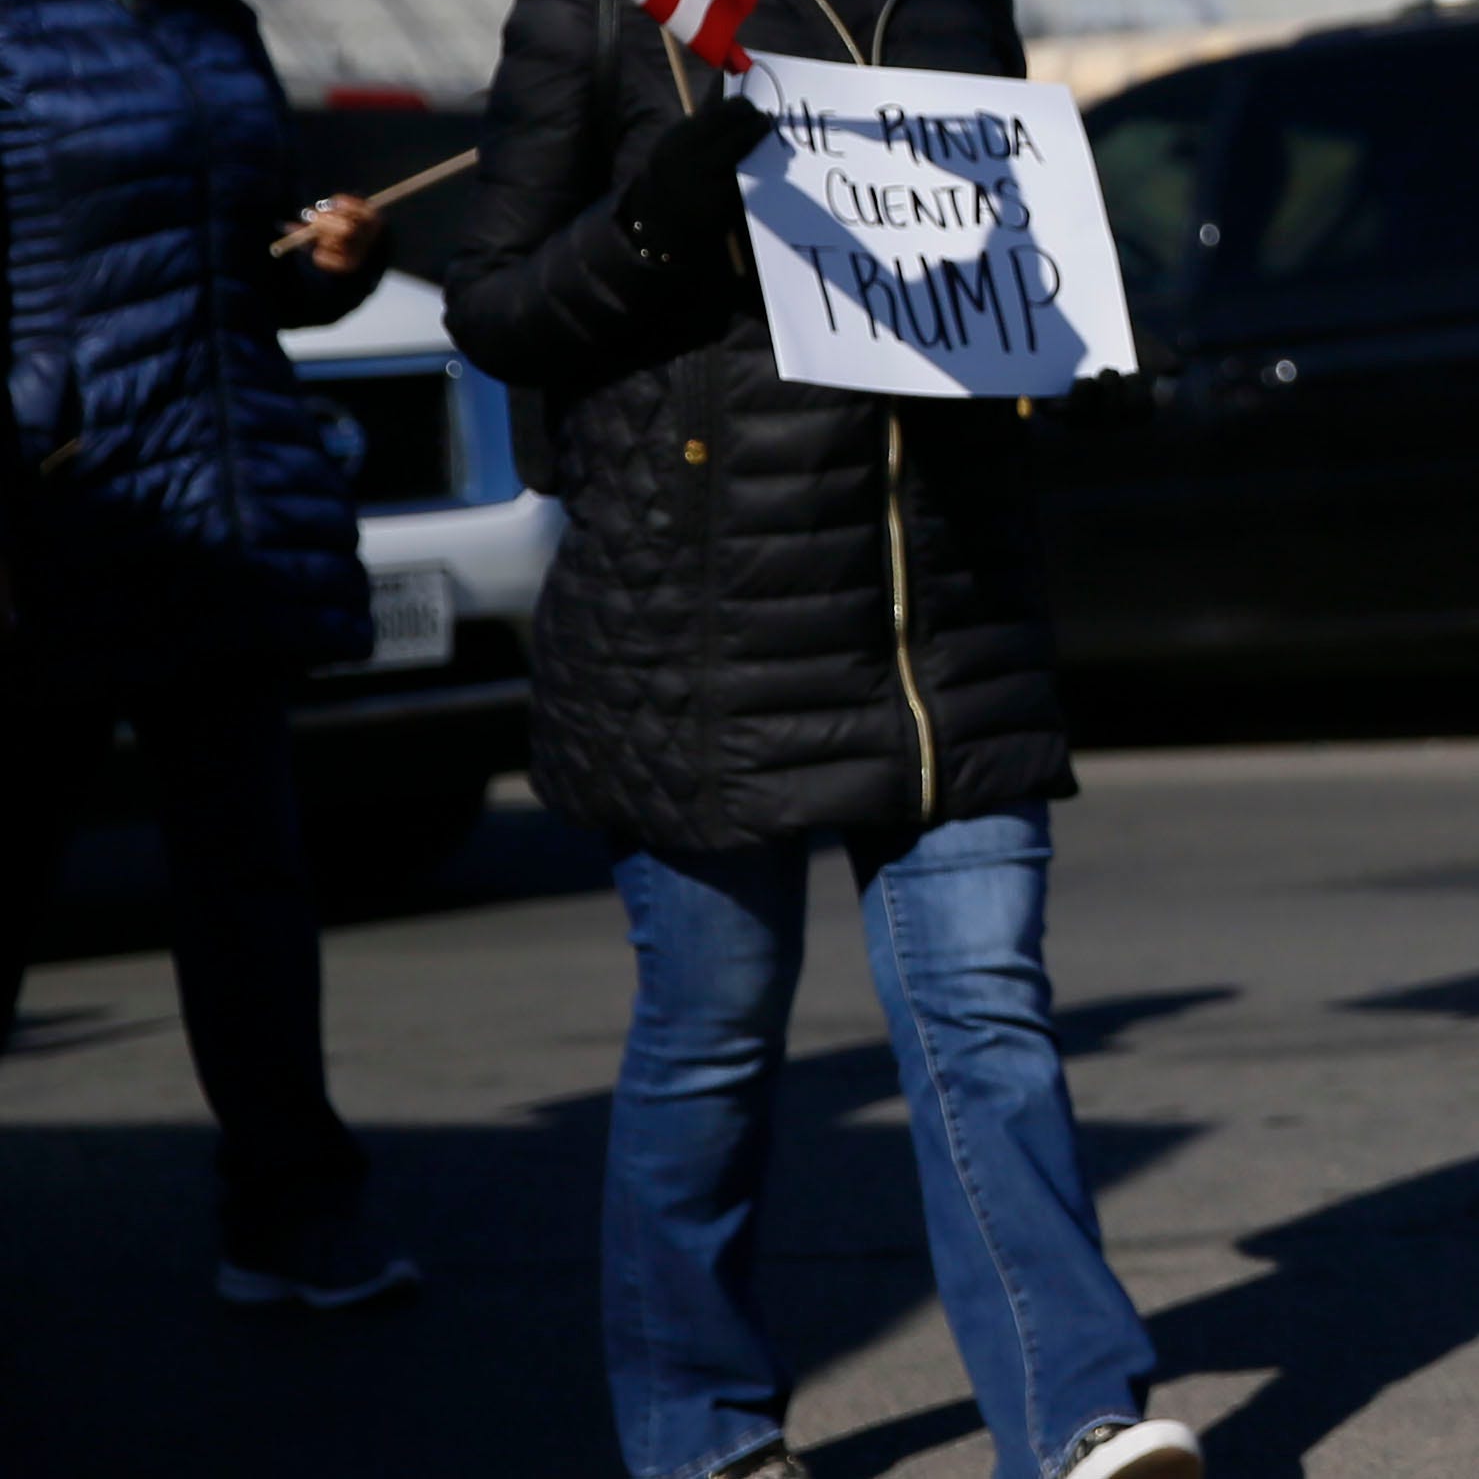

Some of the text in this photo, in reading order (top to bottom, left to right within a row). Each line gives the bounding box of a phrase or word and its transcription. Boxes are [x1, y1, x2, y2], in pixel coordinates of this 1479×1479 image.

[877, 103, 1046, 164] RINDA
[825, 166, 1031, 231] CUENTAS
[791, 244, 1060, 354] TRUMP
